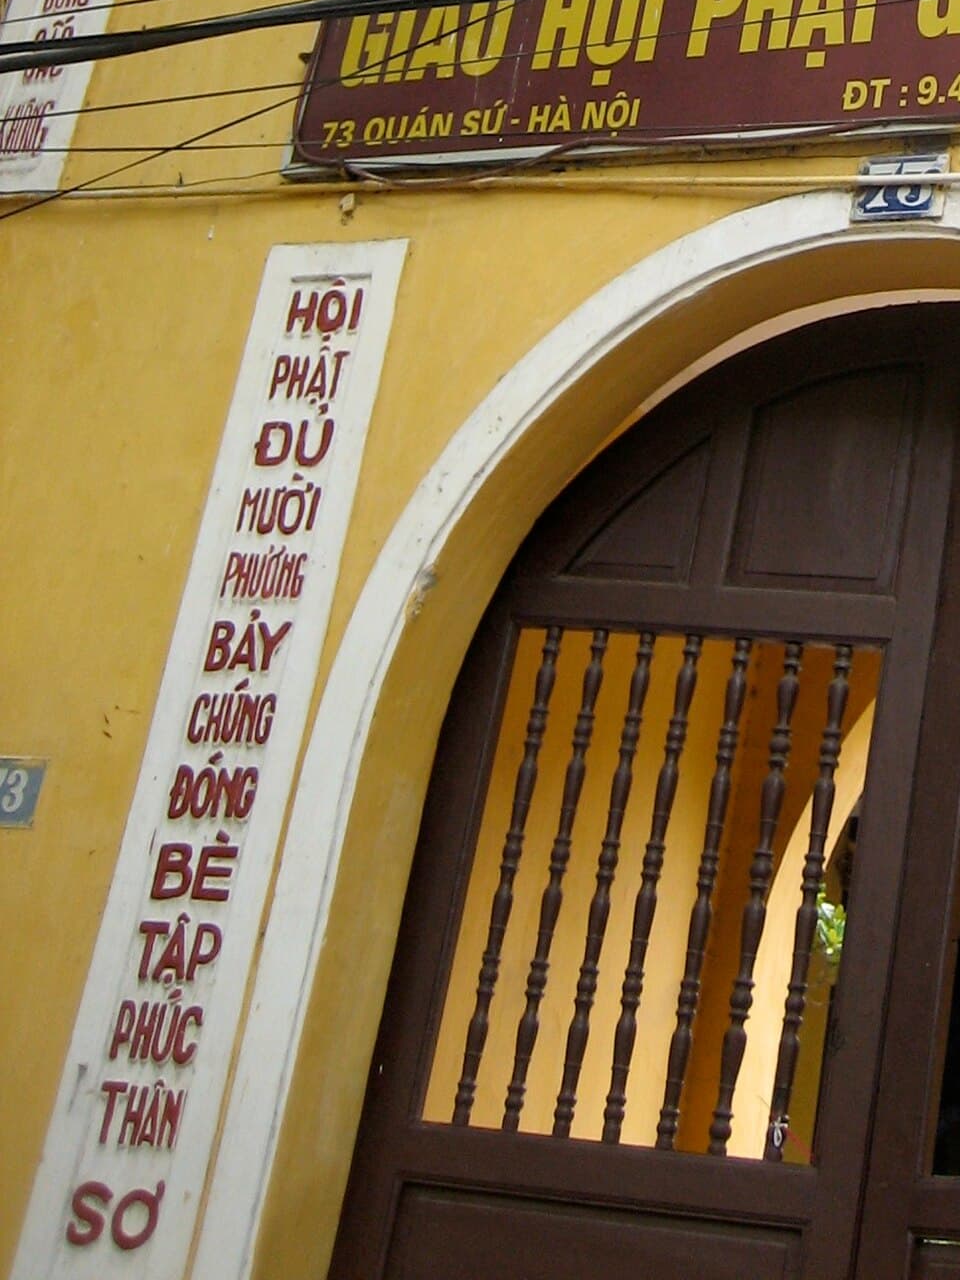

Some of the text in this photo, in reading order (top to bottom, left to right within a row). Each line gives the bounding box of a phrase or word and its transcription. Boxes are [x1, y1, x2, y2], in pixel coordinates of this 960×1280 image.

[322, 120, 356, 149] 73
[364, 107, 454, 146] QUÁN
[460, 99, 508, 137] SỨ
[527, 95, 572, 133] HÀ
[582, 91, 641, 137] NỘI
[842, 78, 891, 111] ĐT
[286, 278, 363, 341] HỘI
[269, 345, 351, 406] PHẬT
[254, 404, 336, 467] ĐỦ
[236, 472, 321, 535] MƯỜI
[203, 609, 293, 672] BẢY
[187, 677, 277, 744] CHÚNG
[168, 750, 259, 819] ĐÓNG
[150, 829, 239, 902] BÈ
[137, 912, 223, 986] TẬP
[109, 989, 204, 1065] PHÚC
[98, 1079, 187, 1149] THÂN
[66, 1179, 165, 1250] SƠ
